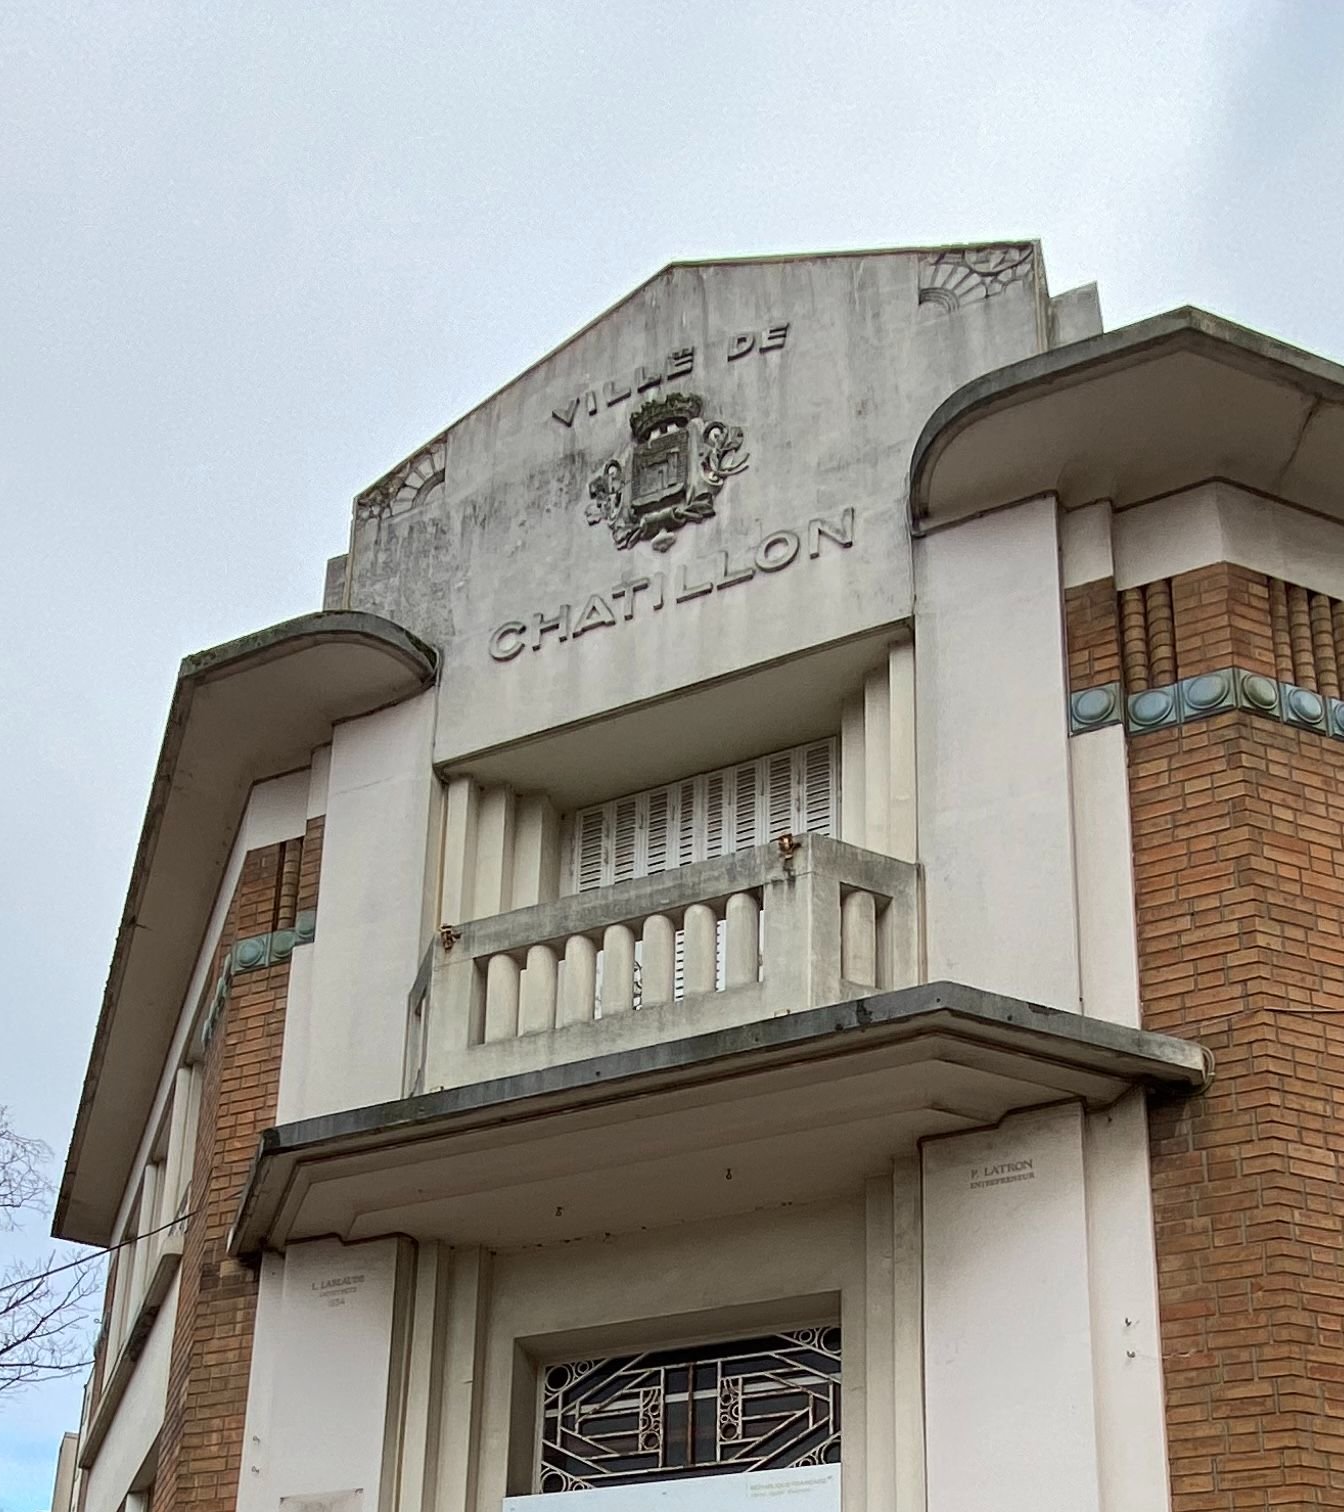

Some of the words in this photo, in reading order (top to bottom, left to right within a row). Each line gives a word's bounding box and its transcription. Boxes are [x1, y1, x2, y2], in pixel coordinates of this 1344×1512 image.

[551, 345, 695, 428] VILLE
[727, 322, 791, 363] DE
[488, 507, 856, 662] CHATILLON
[984, 1159, 1033, 1177] LATRON
